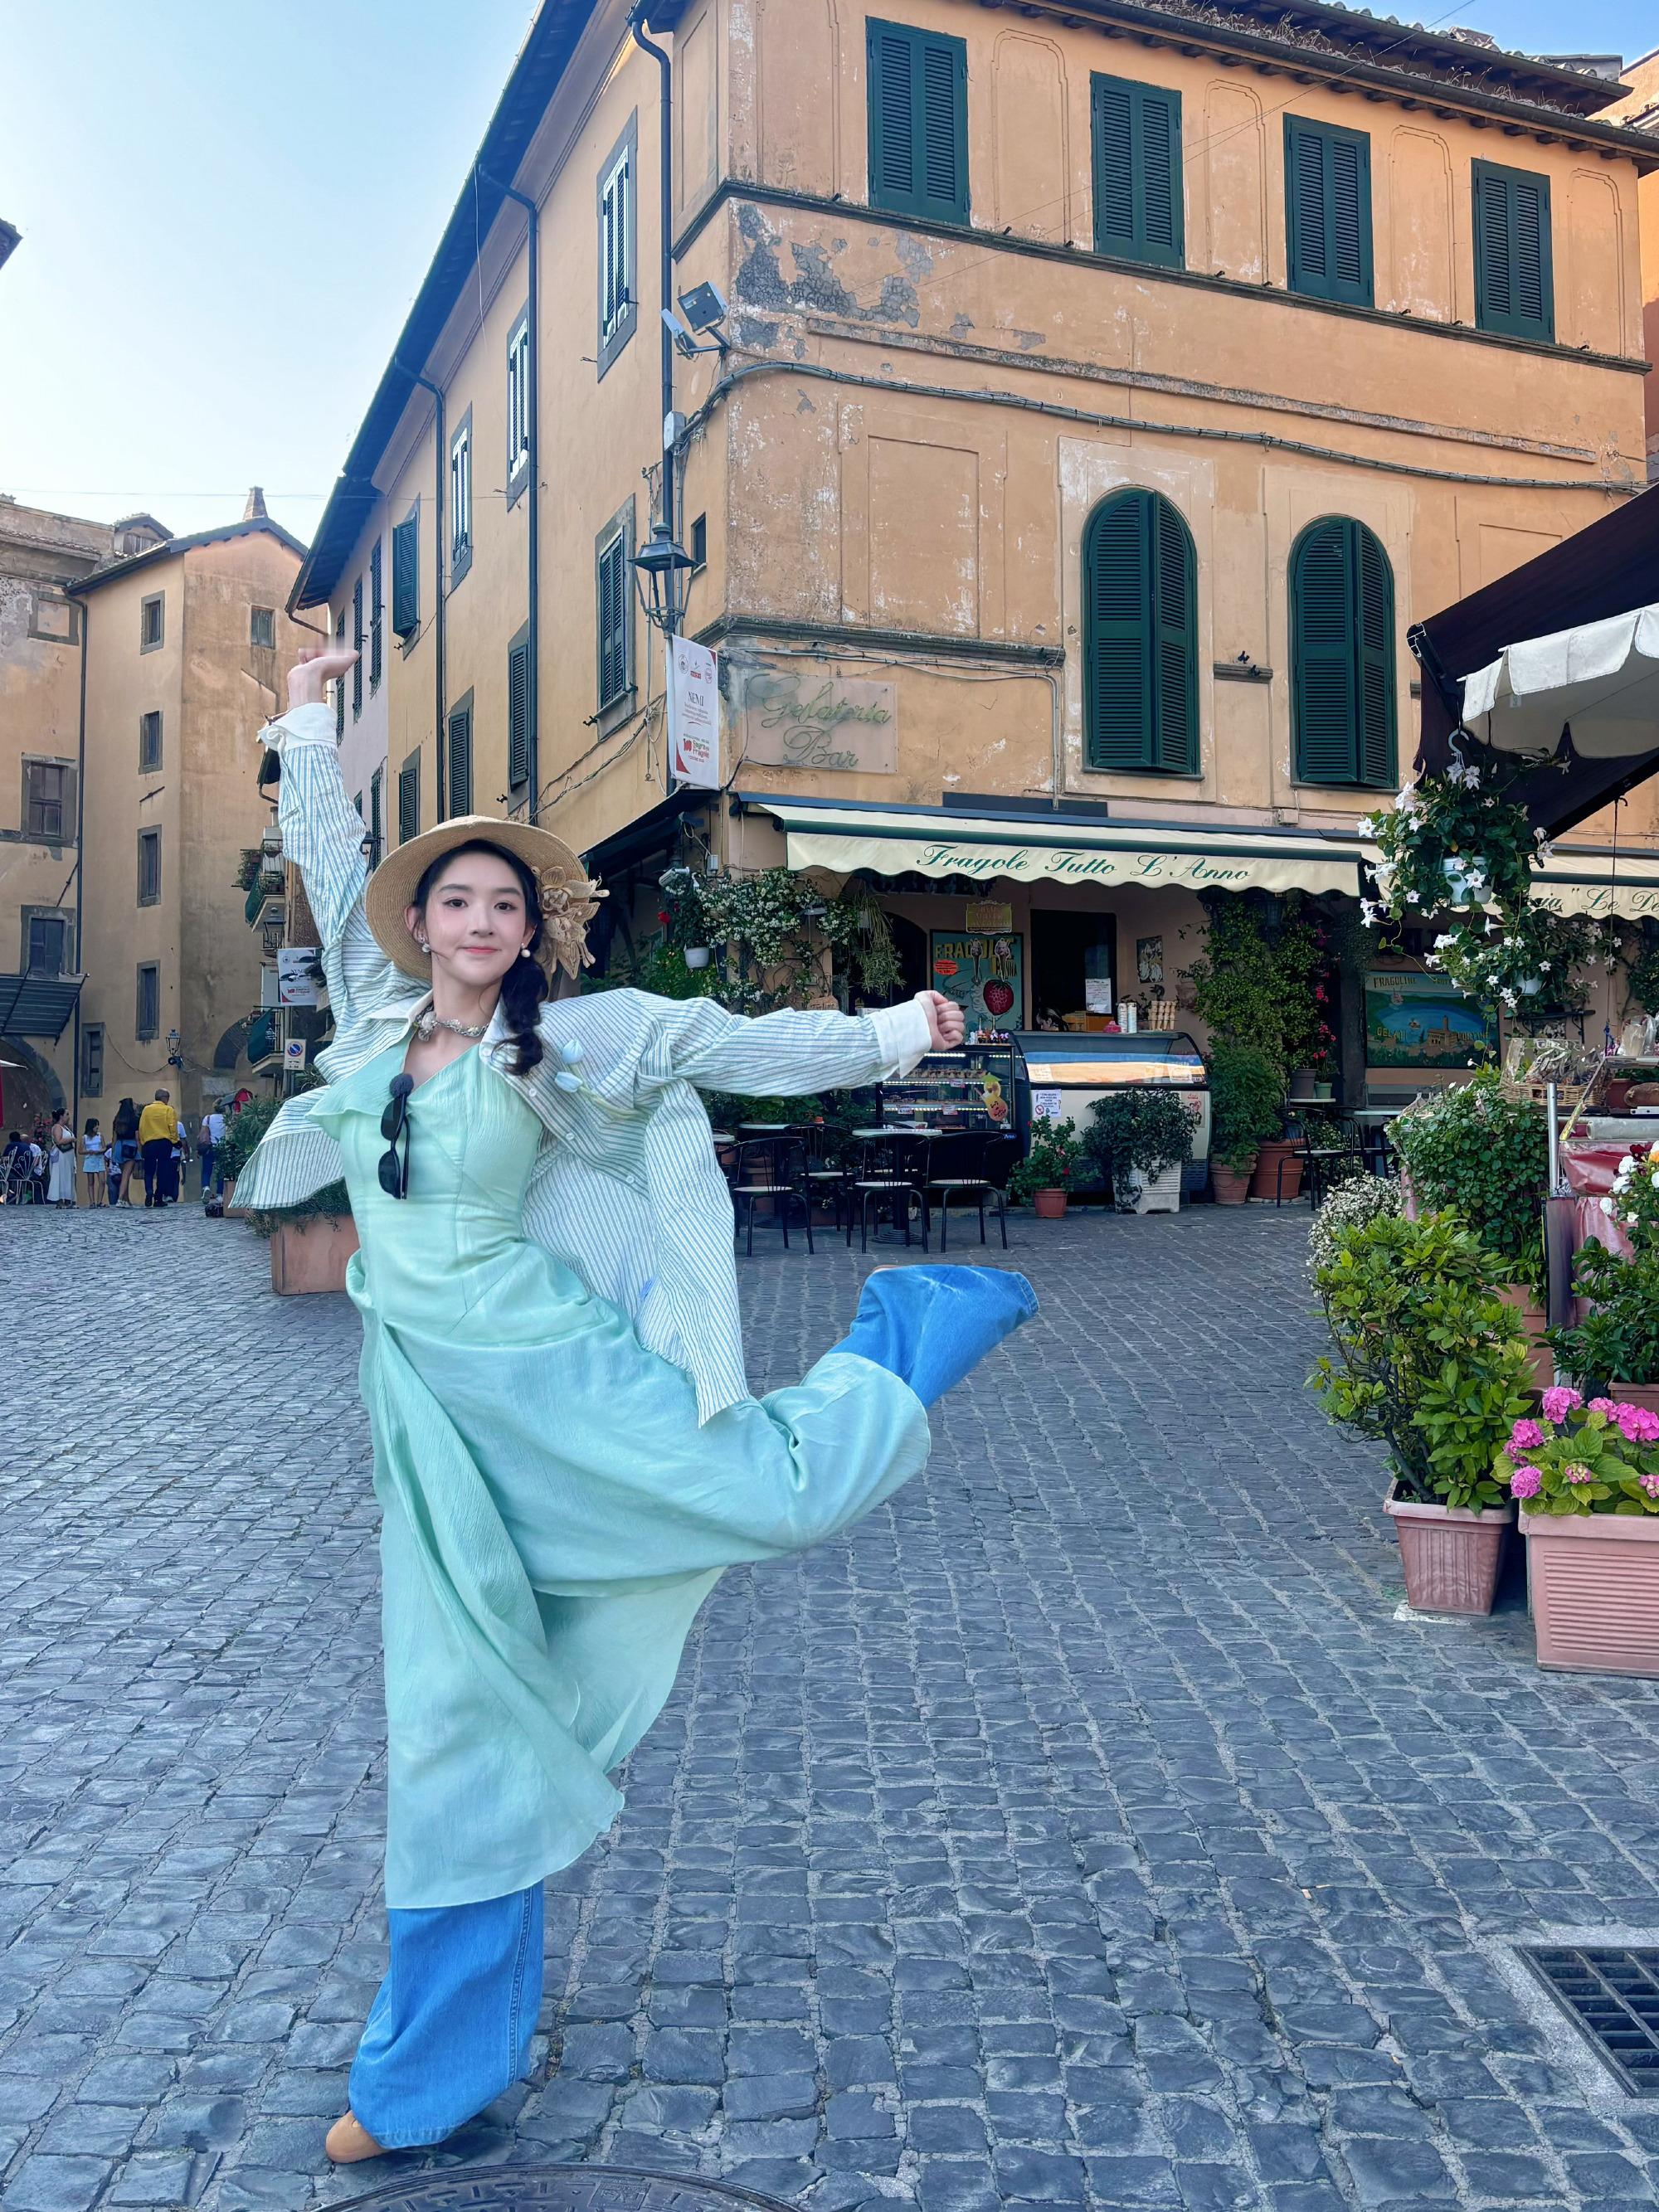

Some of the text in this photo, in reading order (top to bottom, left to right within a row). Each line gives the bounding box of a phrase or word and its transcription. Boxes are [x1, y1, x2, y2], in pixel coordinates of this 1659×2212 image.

[747, 673, 893, 728] Gelateria
[782, 725, 859, 768] Bar
[916, 844, 1030, 875] Fragole
[1044, 851, 1118, 876] Tutto
